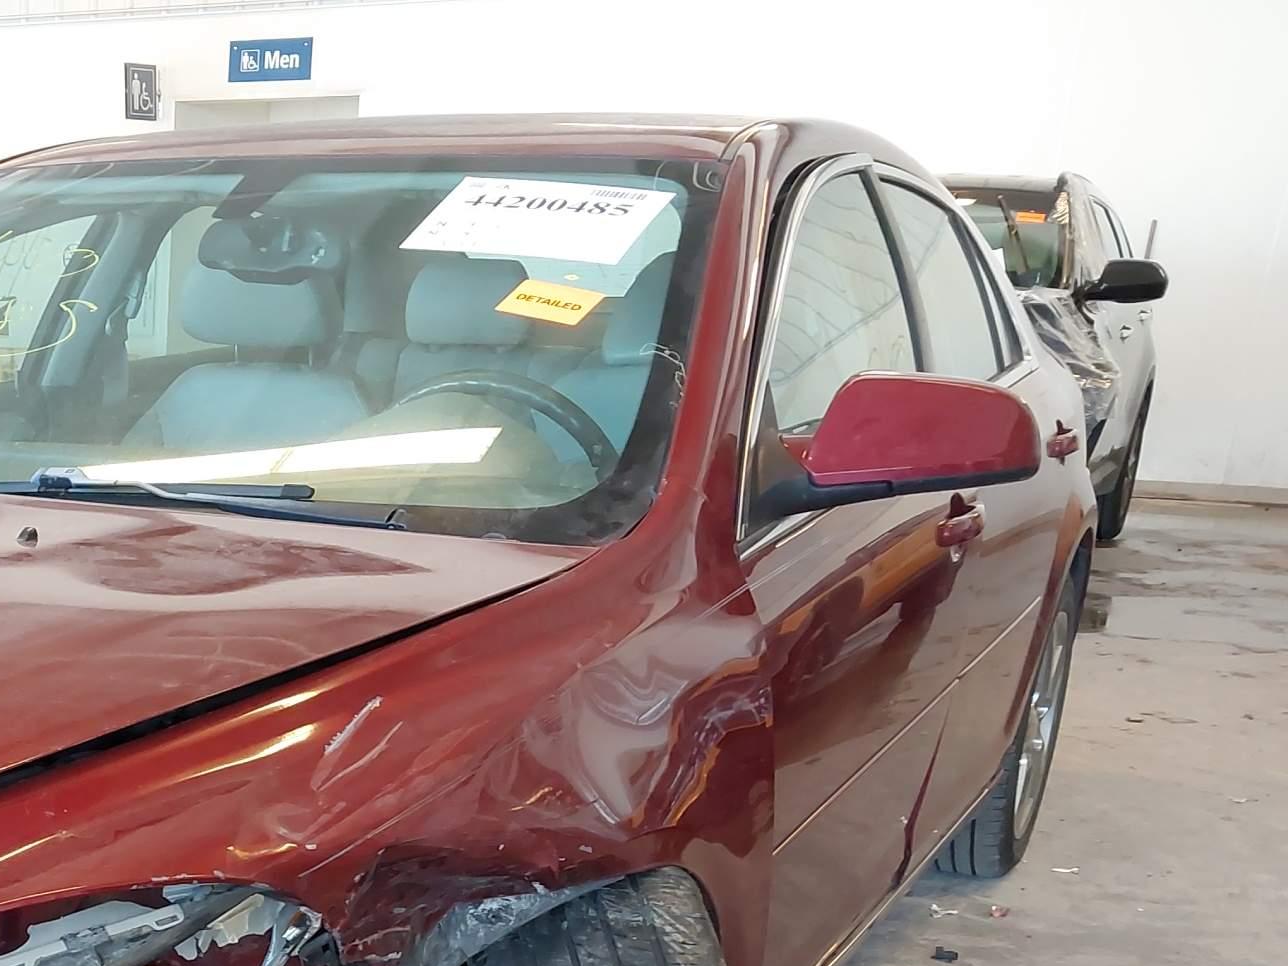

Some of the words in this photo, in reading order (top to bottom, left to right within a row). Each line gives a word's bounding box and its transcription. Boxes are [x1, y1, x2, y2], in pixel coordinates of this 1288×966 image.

[263, 50, 300, 70] Men
[464, 194, 634, 217] 44200485
[516, 293, 582, 312] DETAILED
